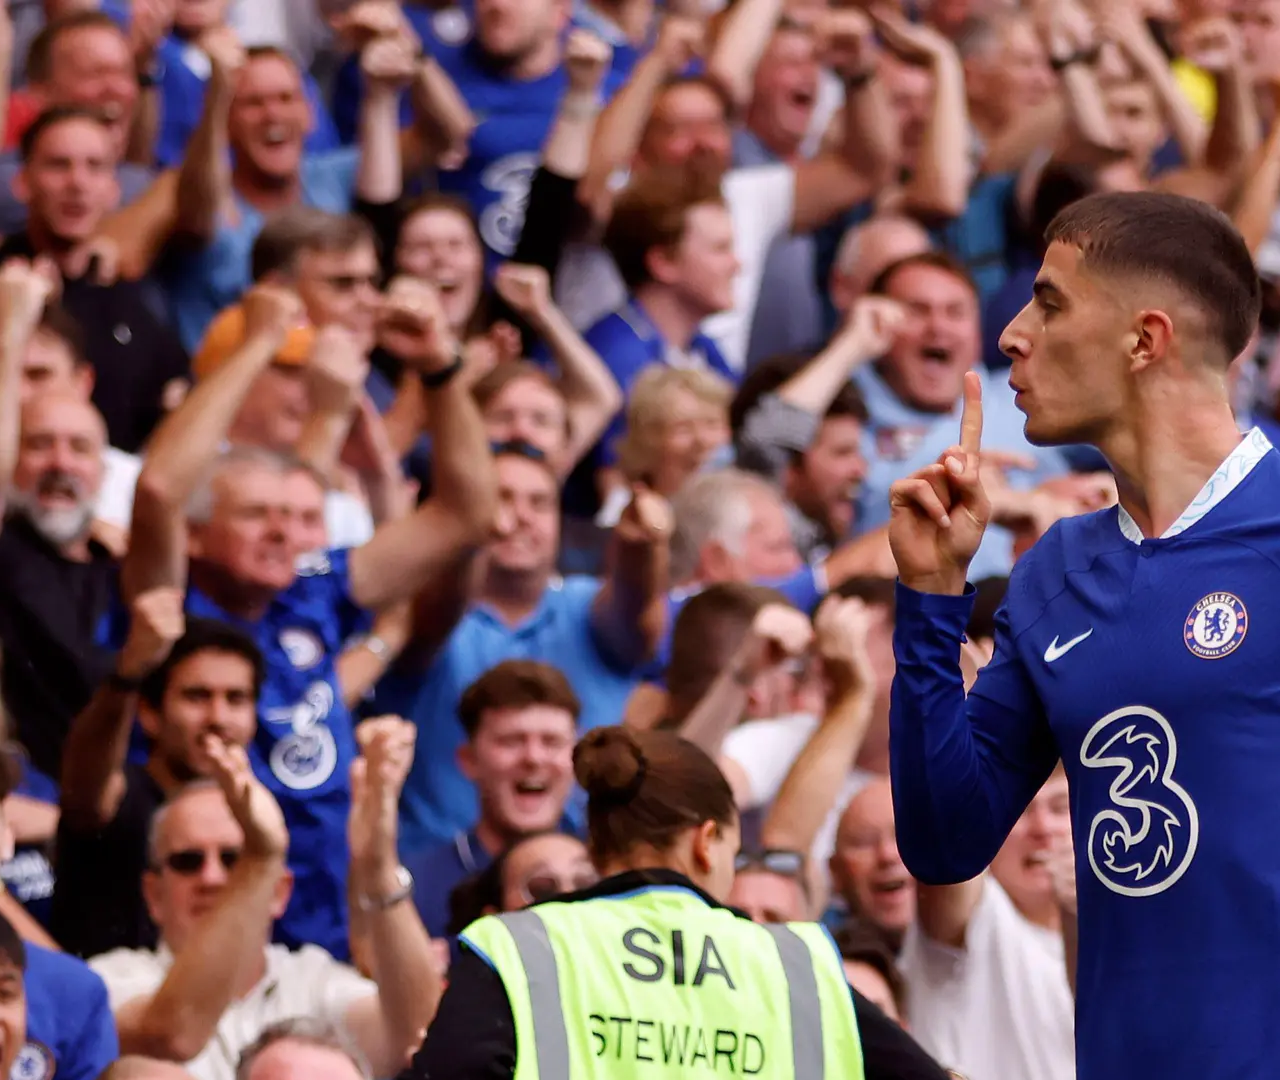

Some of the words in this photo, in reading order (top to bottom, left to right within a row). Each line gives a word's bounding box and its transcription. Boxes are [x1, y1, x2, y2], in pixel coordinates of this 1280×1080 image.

[1196, 594, 1236, 611] CHELSEA
[1192, 644, 1220, 656] FOOTBALL
[1221, 640, 1236, 653] CLUB
[1080, 705, 1199, 897] 3
[622, 927, 736, 990] SIA
[589, 1014, 766, 1075] STEWARD
